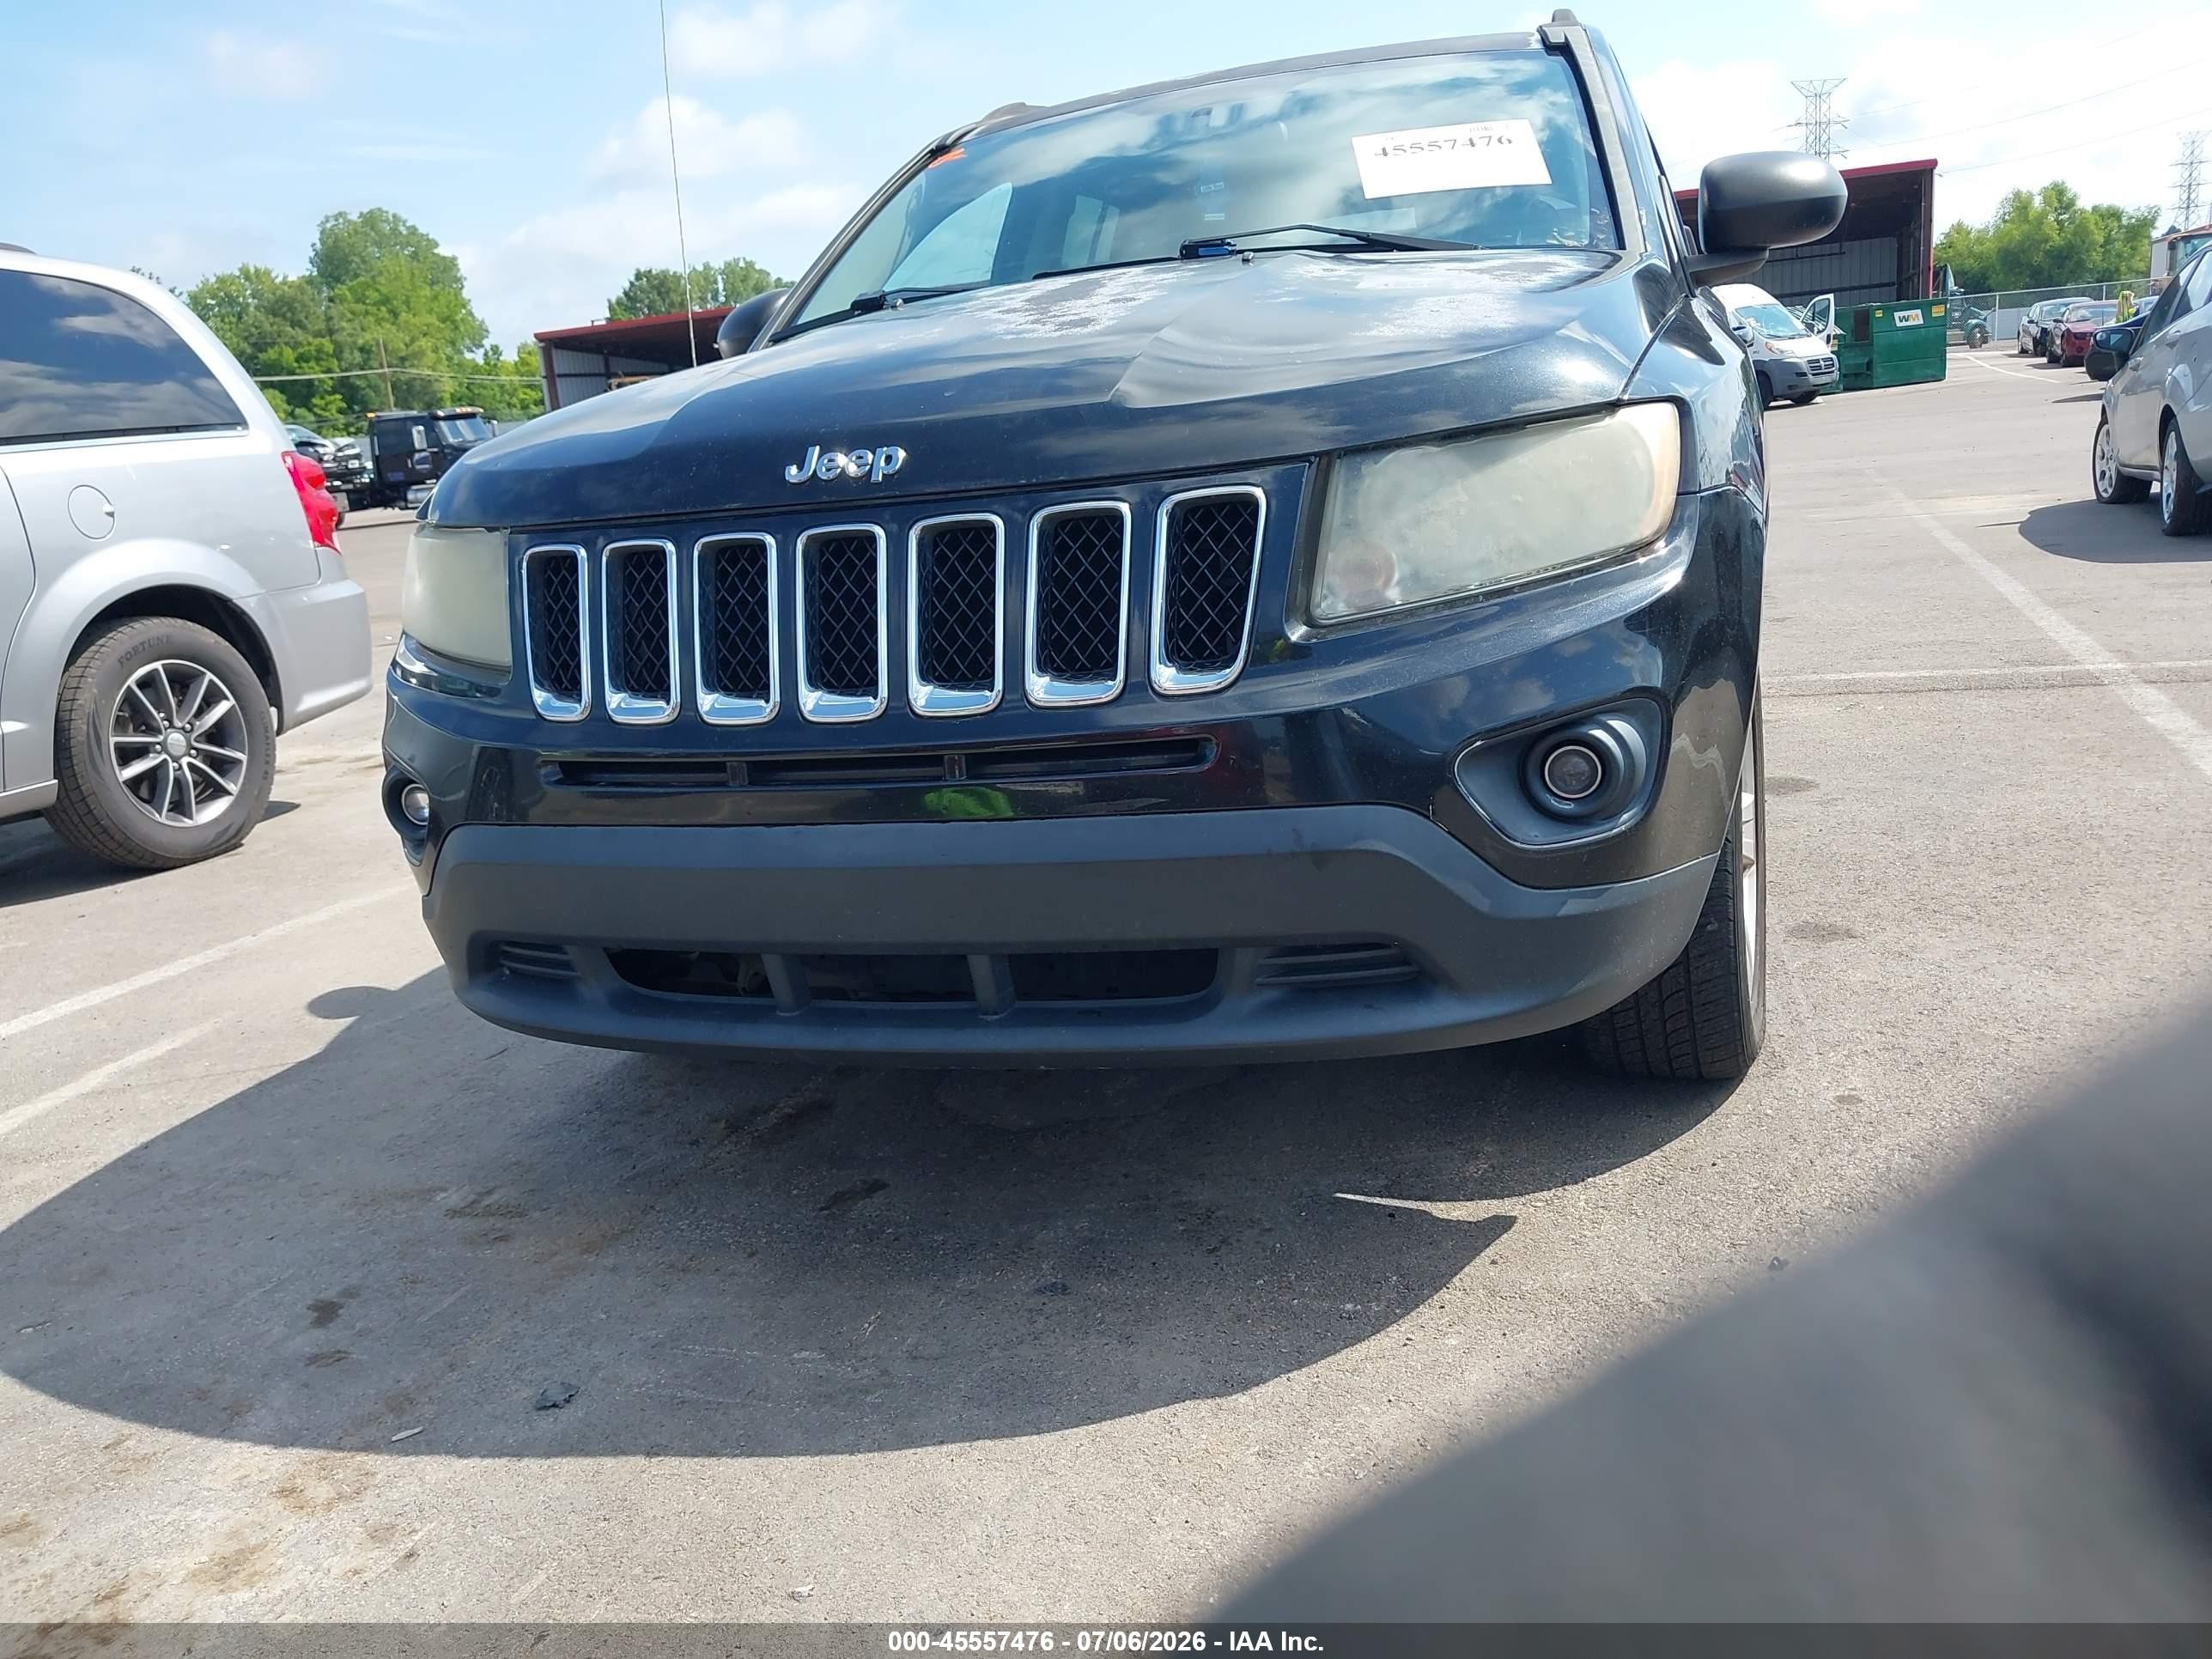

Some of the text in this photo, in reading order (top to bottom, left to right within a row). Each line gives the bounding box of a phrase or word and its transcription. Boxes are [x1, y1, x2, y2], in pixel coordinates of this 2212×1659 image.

[1374, 135, 1513, 157] 45557476
[1898, 313, 1920, 324] WM
[785, 445, 907, 483] Jeep
